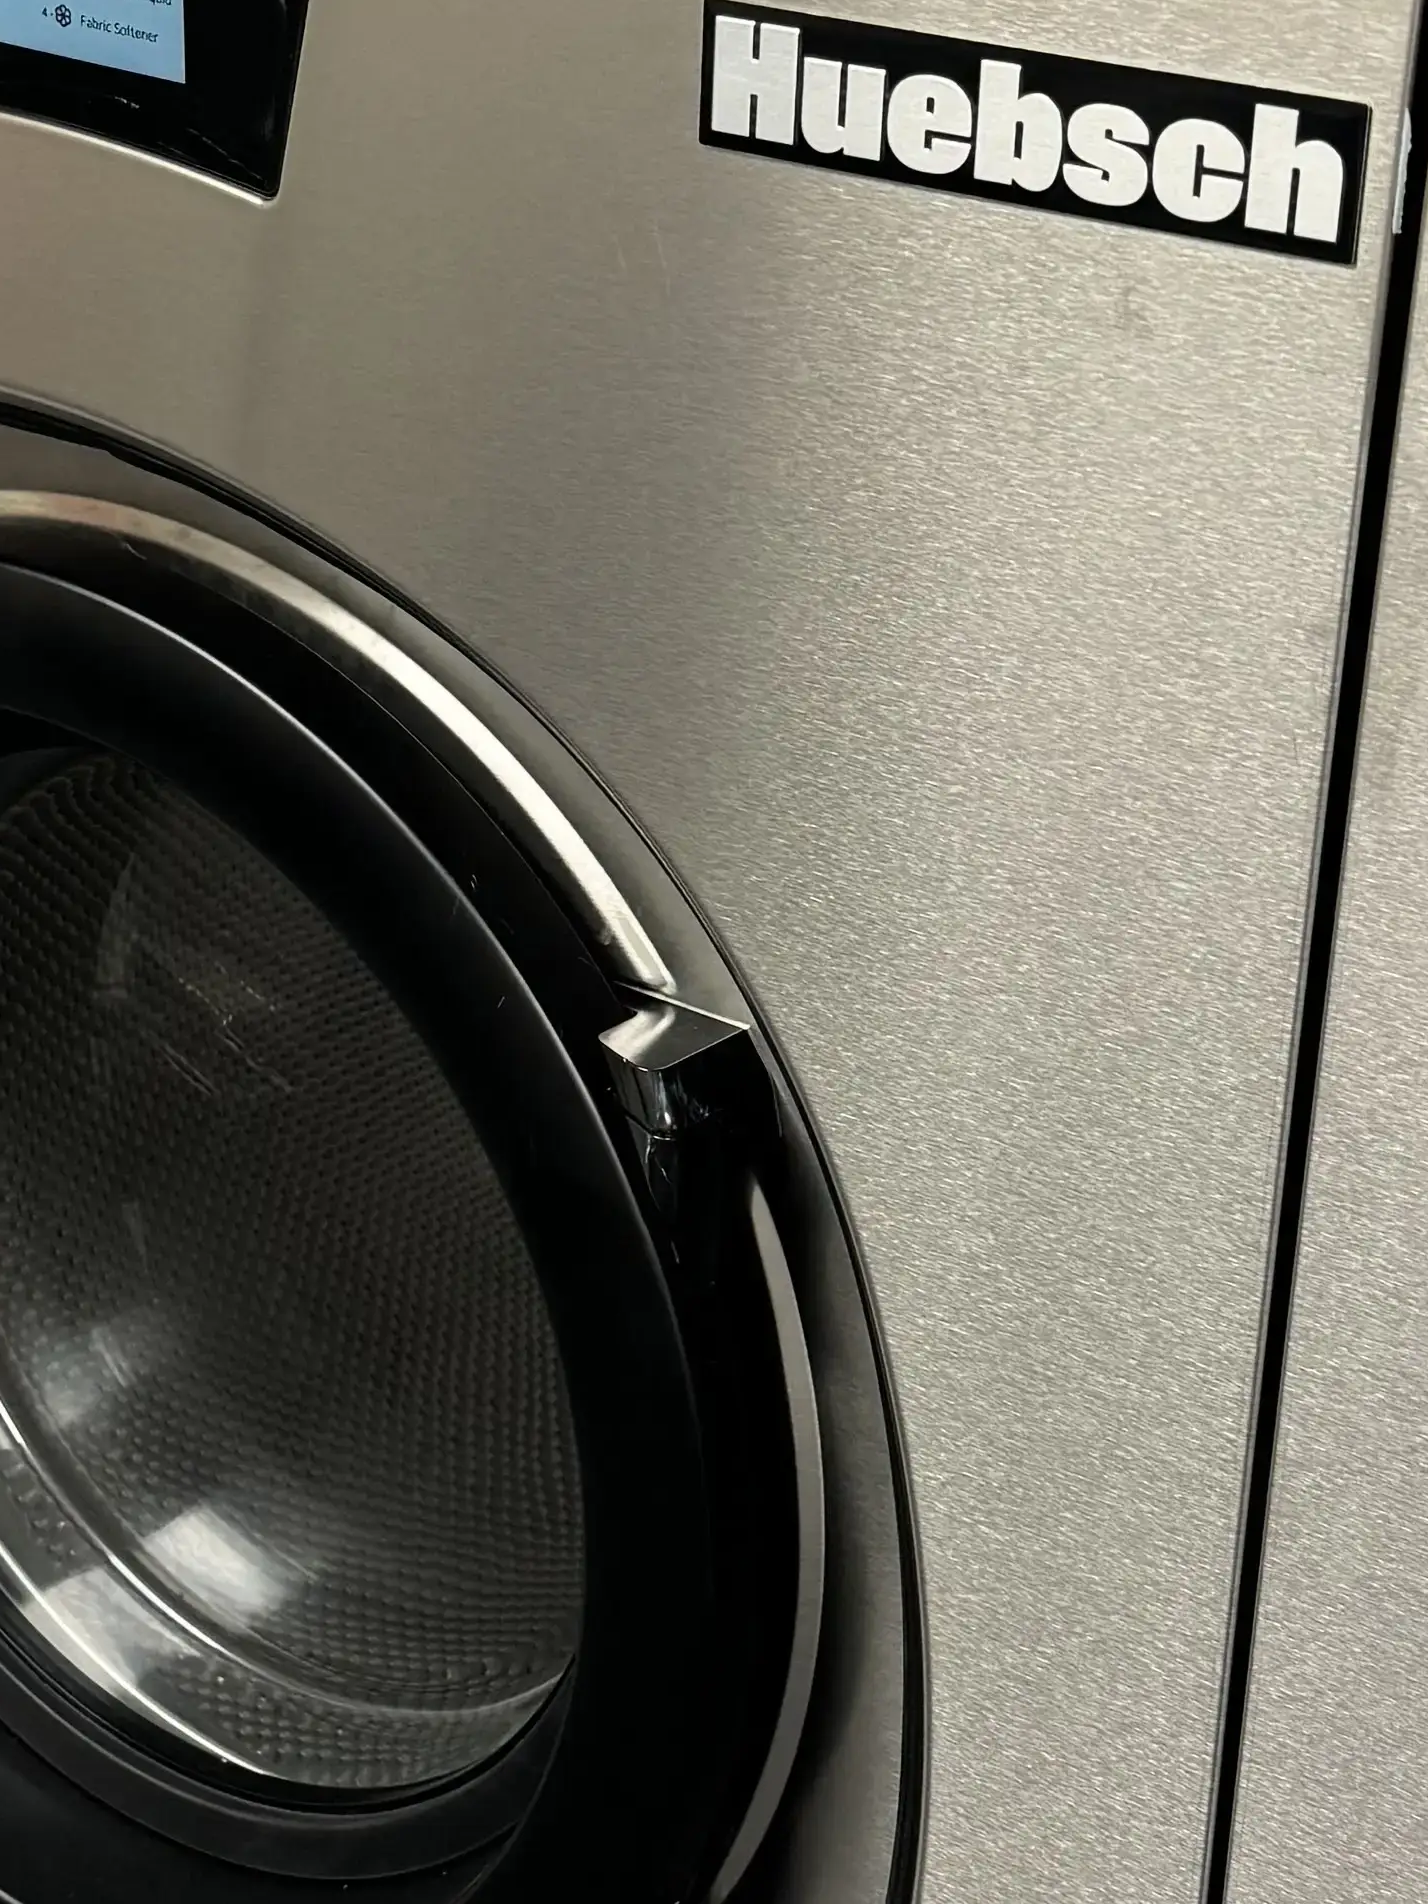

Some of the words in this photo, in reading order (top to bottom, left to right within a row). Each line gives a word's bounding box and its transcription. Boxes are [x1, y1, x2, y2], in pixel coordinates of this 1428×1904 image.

[80, 14, 112, 33] Fabric
[114, 22, 159, 43] Softener
[711, 15, 1345, 243] Huebsch
